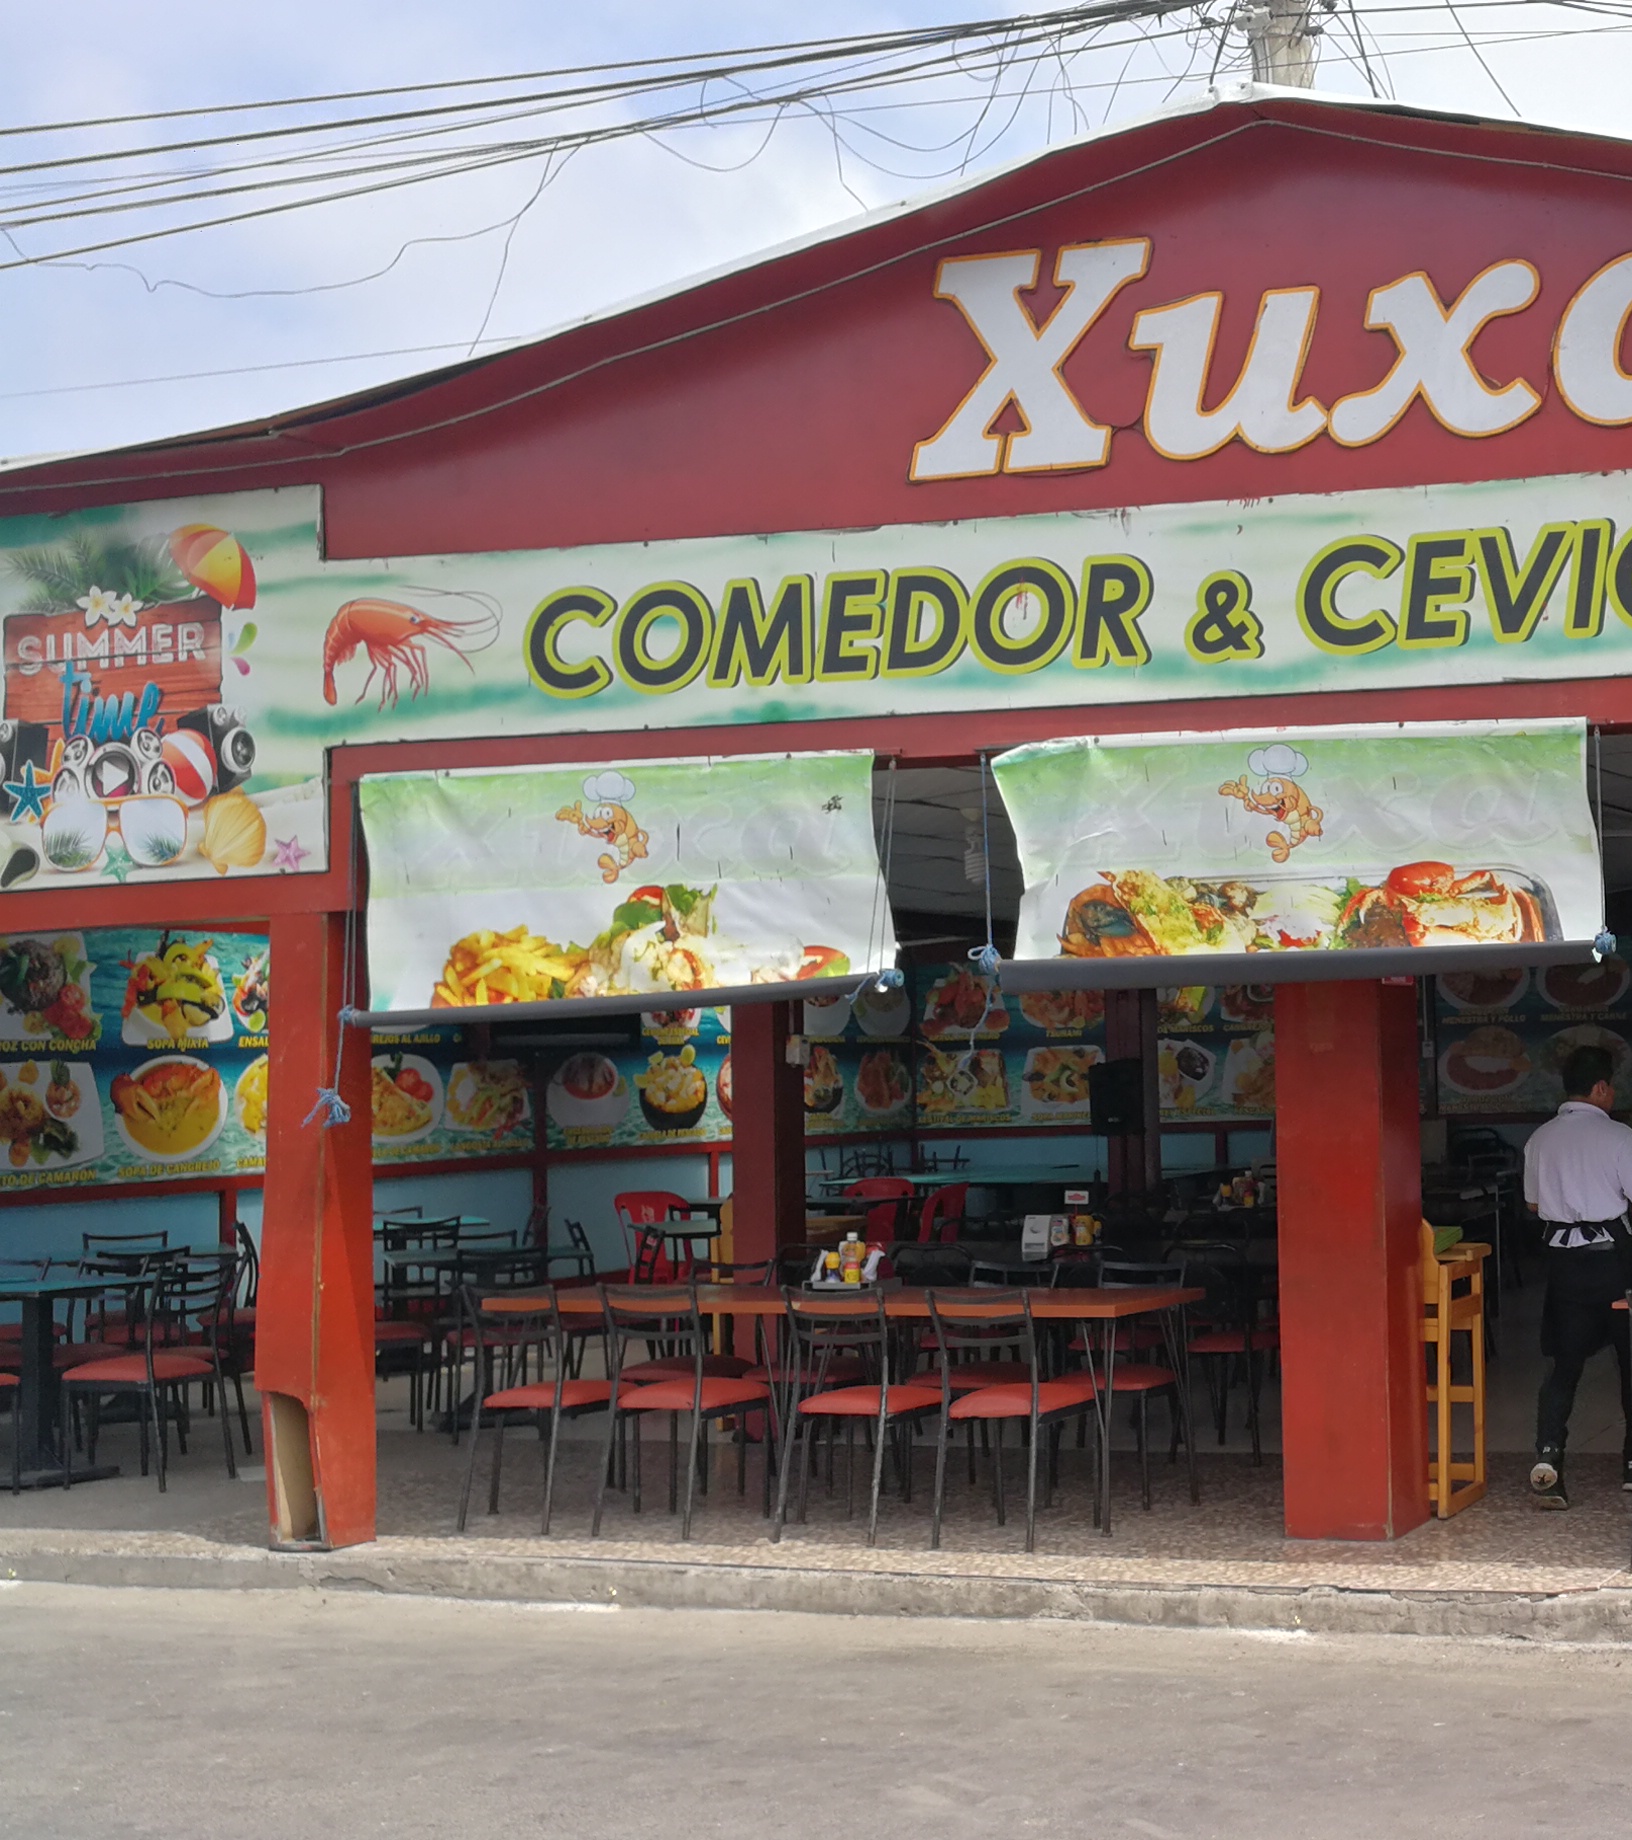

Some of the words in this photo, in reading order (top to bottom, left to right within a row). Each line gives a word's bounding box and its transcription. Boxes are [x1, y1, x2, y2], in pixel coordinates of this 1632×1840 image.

[524, 554, 1153, 699] COMEDOR
[1184, 569, 1264, 664] &
[17, 622, 207, 676] SUMMER
[59, 660, 165, 743] time
[0, 1039, 18, 1052] OZ
[21, 1040, 47, 1052] CON
[48, 1039, 97, 1052] CONCHA
[146, 1038, 175, 1050] SOPA
[238, 1036, 269, 1048] ENSAL
[371, 1034, 400, 1045] REJOS
[236, 1157, 267, 1168] CAMA
